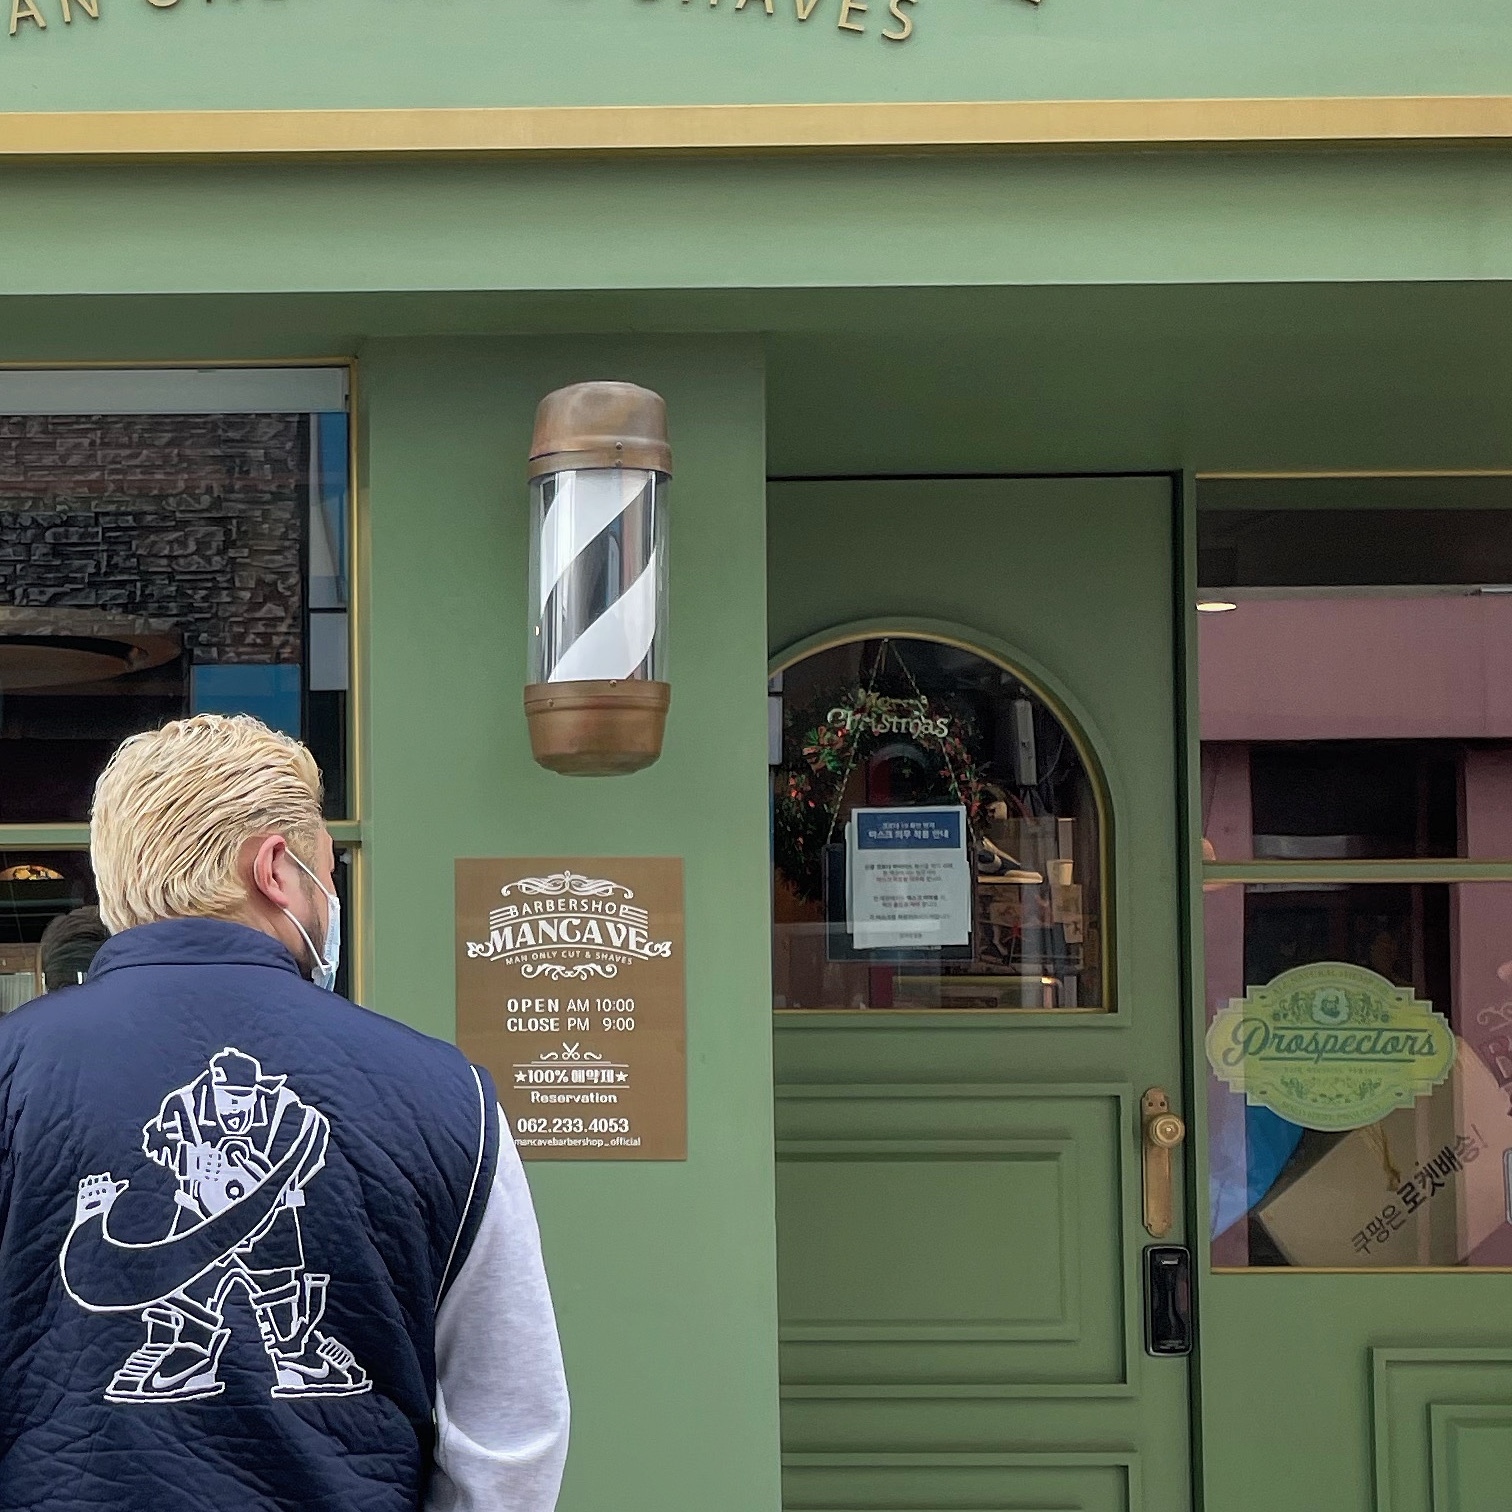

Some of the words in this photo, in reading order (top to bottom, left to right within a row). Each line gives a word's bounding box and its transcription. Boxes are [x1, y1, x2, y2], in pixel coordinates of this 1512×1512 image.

[490, 918, 649, 953] MANCAVE
[505, 955, 528, 965] MAN
[531, 950, 558, 961] ONLY
[561, 950, 580, 959] CUT
[595, 951, 633, 966] SHAVES
[507, 998, 559, 1013] OPEN
[566, 998, 590, 1012] AM
[596, 998, 635, 1013] 10:00
[506, 1017, 560, 1032] CLOSE
[567, 1017, 590, 1031] PM
[602, 1017, 635, 1032] 9:00
[1223, 1018, 1436, 1066] Prospectors
[527, 1069, 569, 1084] 100%
[531, 1091, 618, 1104] Reservation
[517, 1118, 630, 1133] 062.233.4053
[1351, 1205, 1406, 1254] 쿠팡은
